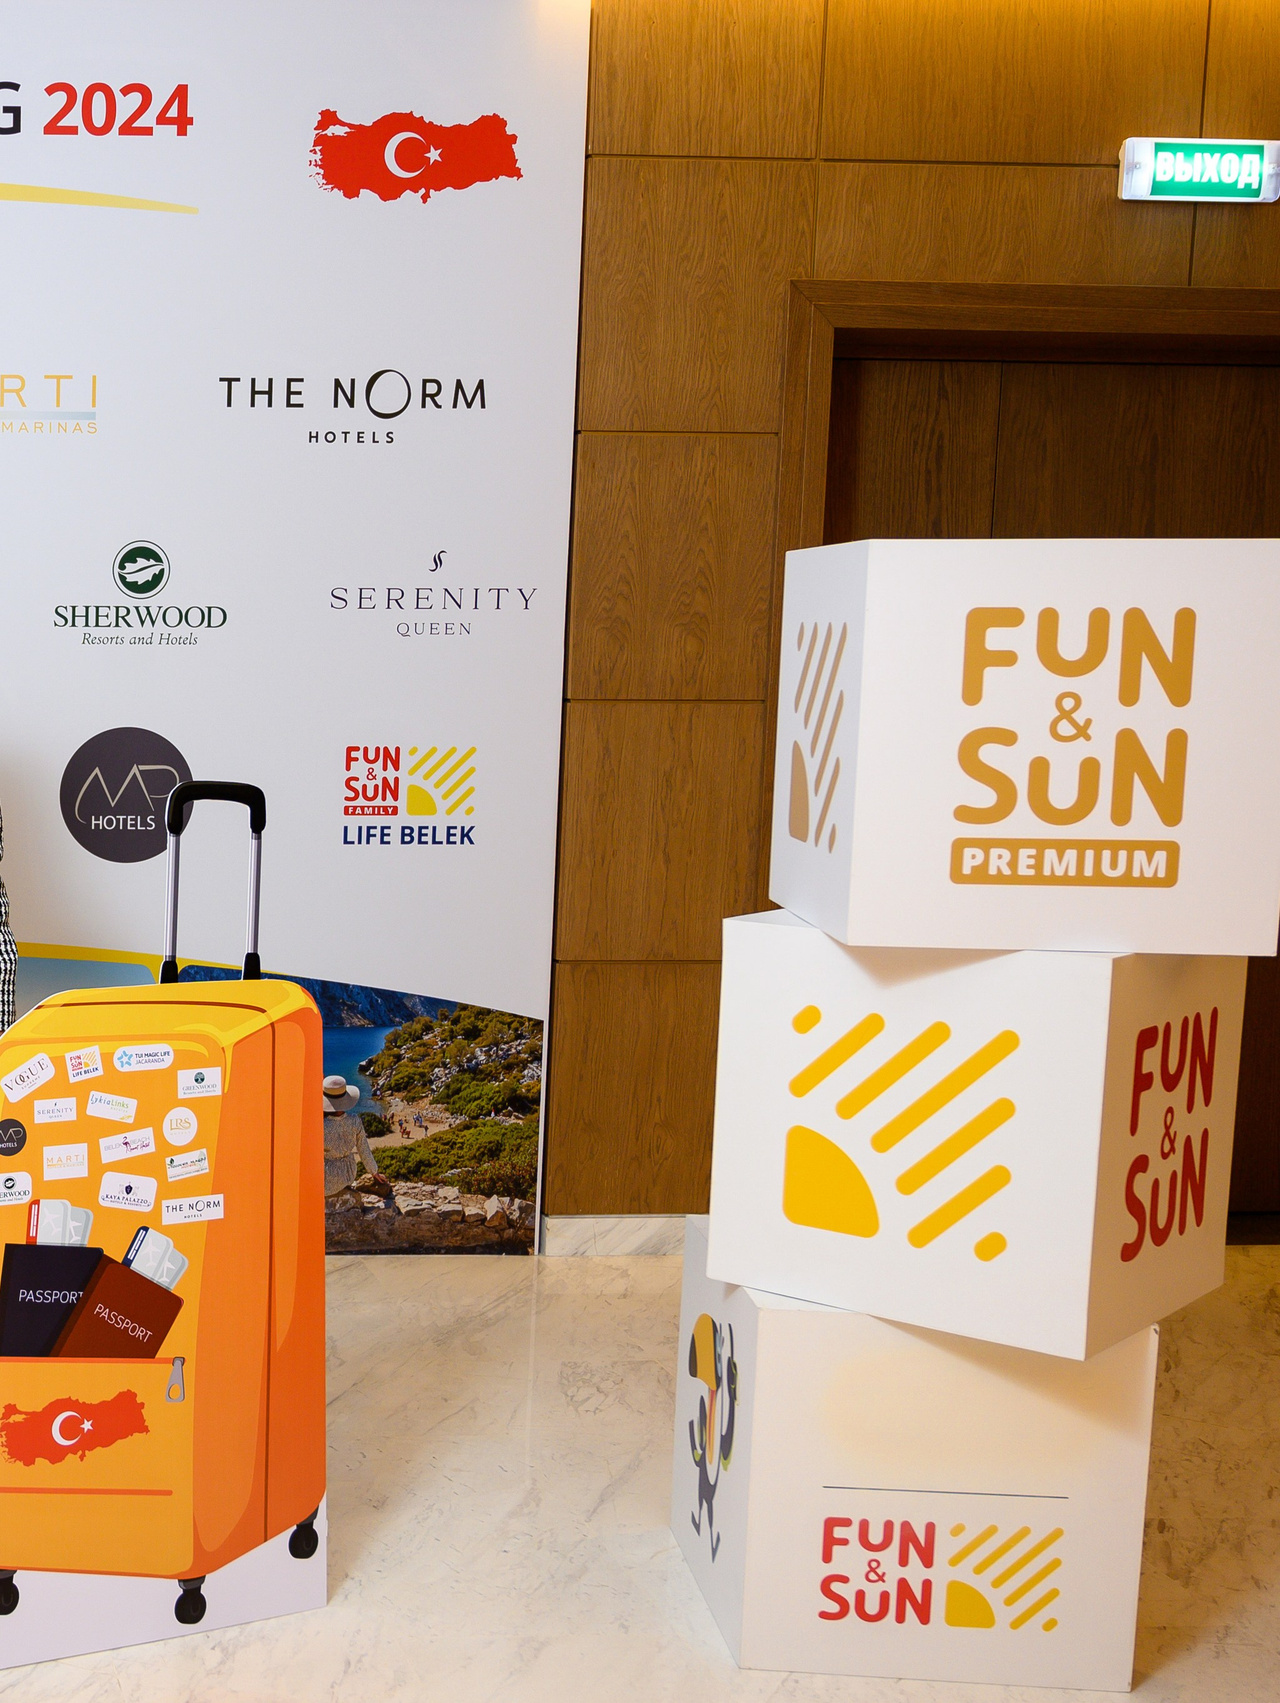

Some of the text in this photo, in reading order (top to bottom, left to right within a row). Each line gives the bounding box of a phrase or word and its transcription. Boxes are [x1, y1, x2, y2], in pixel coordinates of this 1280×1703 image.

[43, 81, 195, 137] 2024
[1155, 151, 1260, 189] ВЫХОД
[219, 369, 486, 419] THE NORM
[1, 422, 98, 434] MARINAS
[308, 431, 395, 444] HOTELS
[330, 587, 538, 610] SERENITY
[54, 605, 228, 628] SHERWOOD
[82, 632, 198, 646] Resorts and Hotels
[396, 622, 471, 637] QUEEN
[962, 606, 1196, 708] FUN
[1049, 691, 1093, 743] &
[345, 746, 401, 772] FUN
[366, 767, 377, 781] &
[953, 727, 1188, 827] SUN
[344, 776, 399, 802] SUN
[91, 815, 156, 830] HOTELS
[348, 807, 393, 815] FAMILY
[343, 825, 475, 845] LIFE BELEK
[962, 847, 1167, 878] PREMIUM
[135, 1057, 165, 1065] JACARANDA
[1130, 1006, 1218, 1137] FUN
[4, 1058, 49, 1091] VOGUE
[72, 1070, 83, 1078] LIFE
[182, 1083, 217, 1092] GREENWOOD
[37, 1107, 73, 1116] SERENITY
[169, 1118, 192, 1131] LRS
[1160, 1105, 1177, 1160] &
[46, 1154, 85, 1164] MARTI
[121, 1196, 149, 1205] PALAZZO
[165, 1200, 221, 1213] THE NORM
[1120, 1127, 1209, 1263] SUN
[93, 1303, 153, 1343] PASSPORT
[821, 1516, 936, 1569] FUN
[865, 1558, 887, 1584] &
[818, 1573, 932, 1626] SUN
